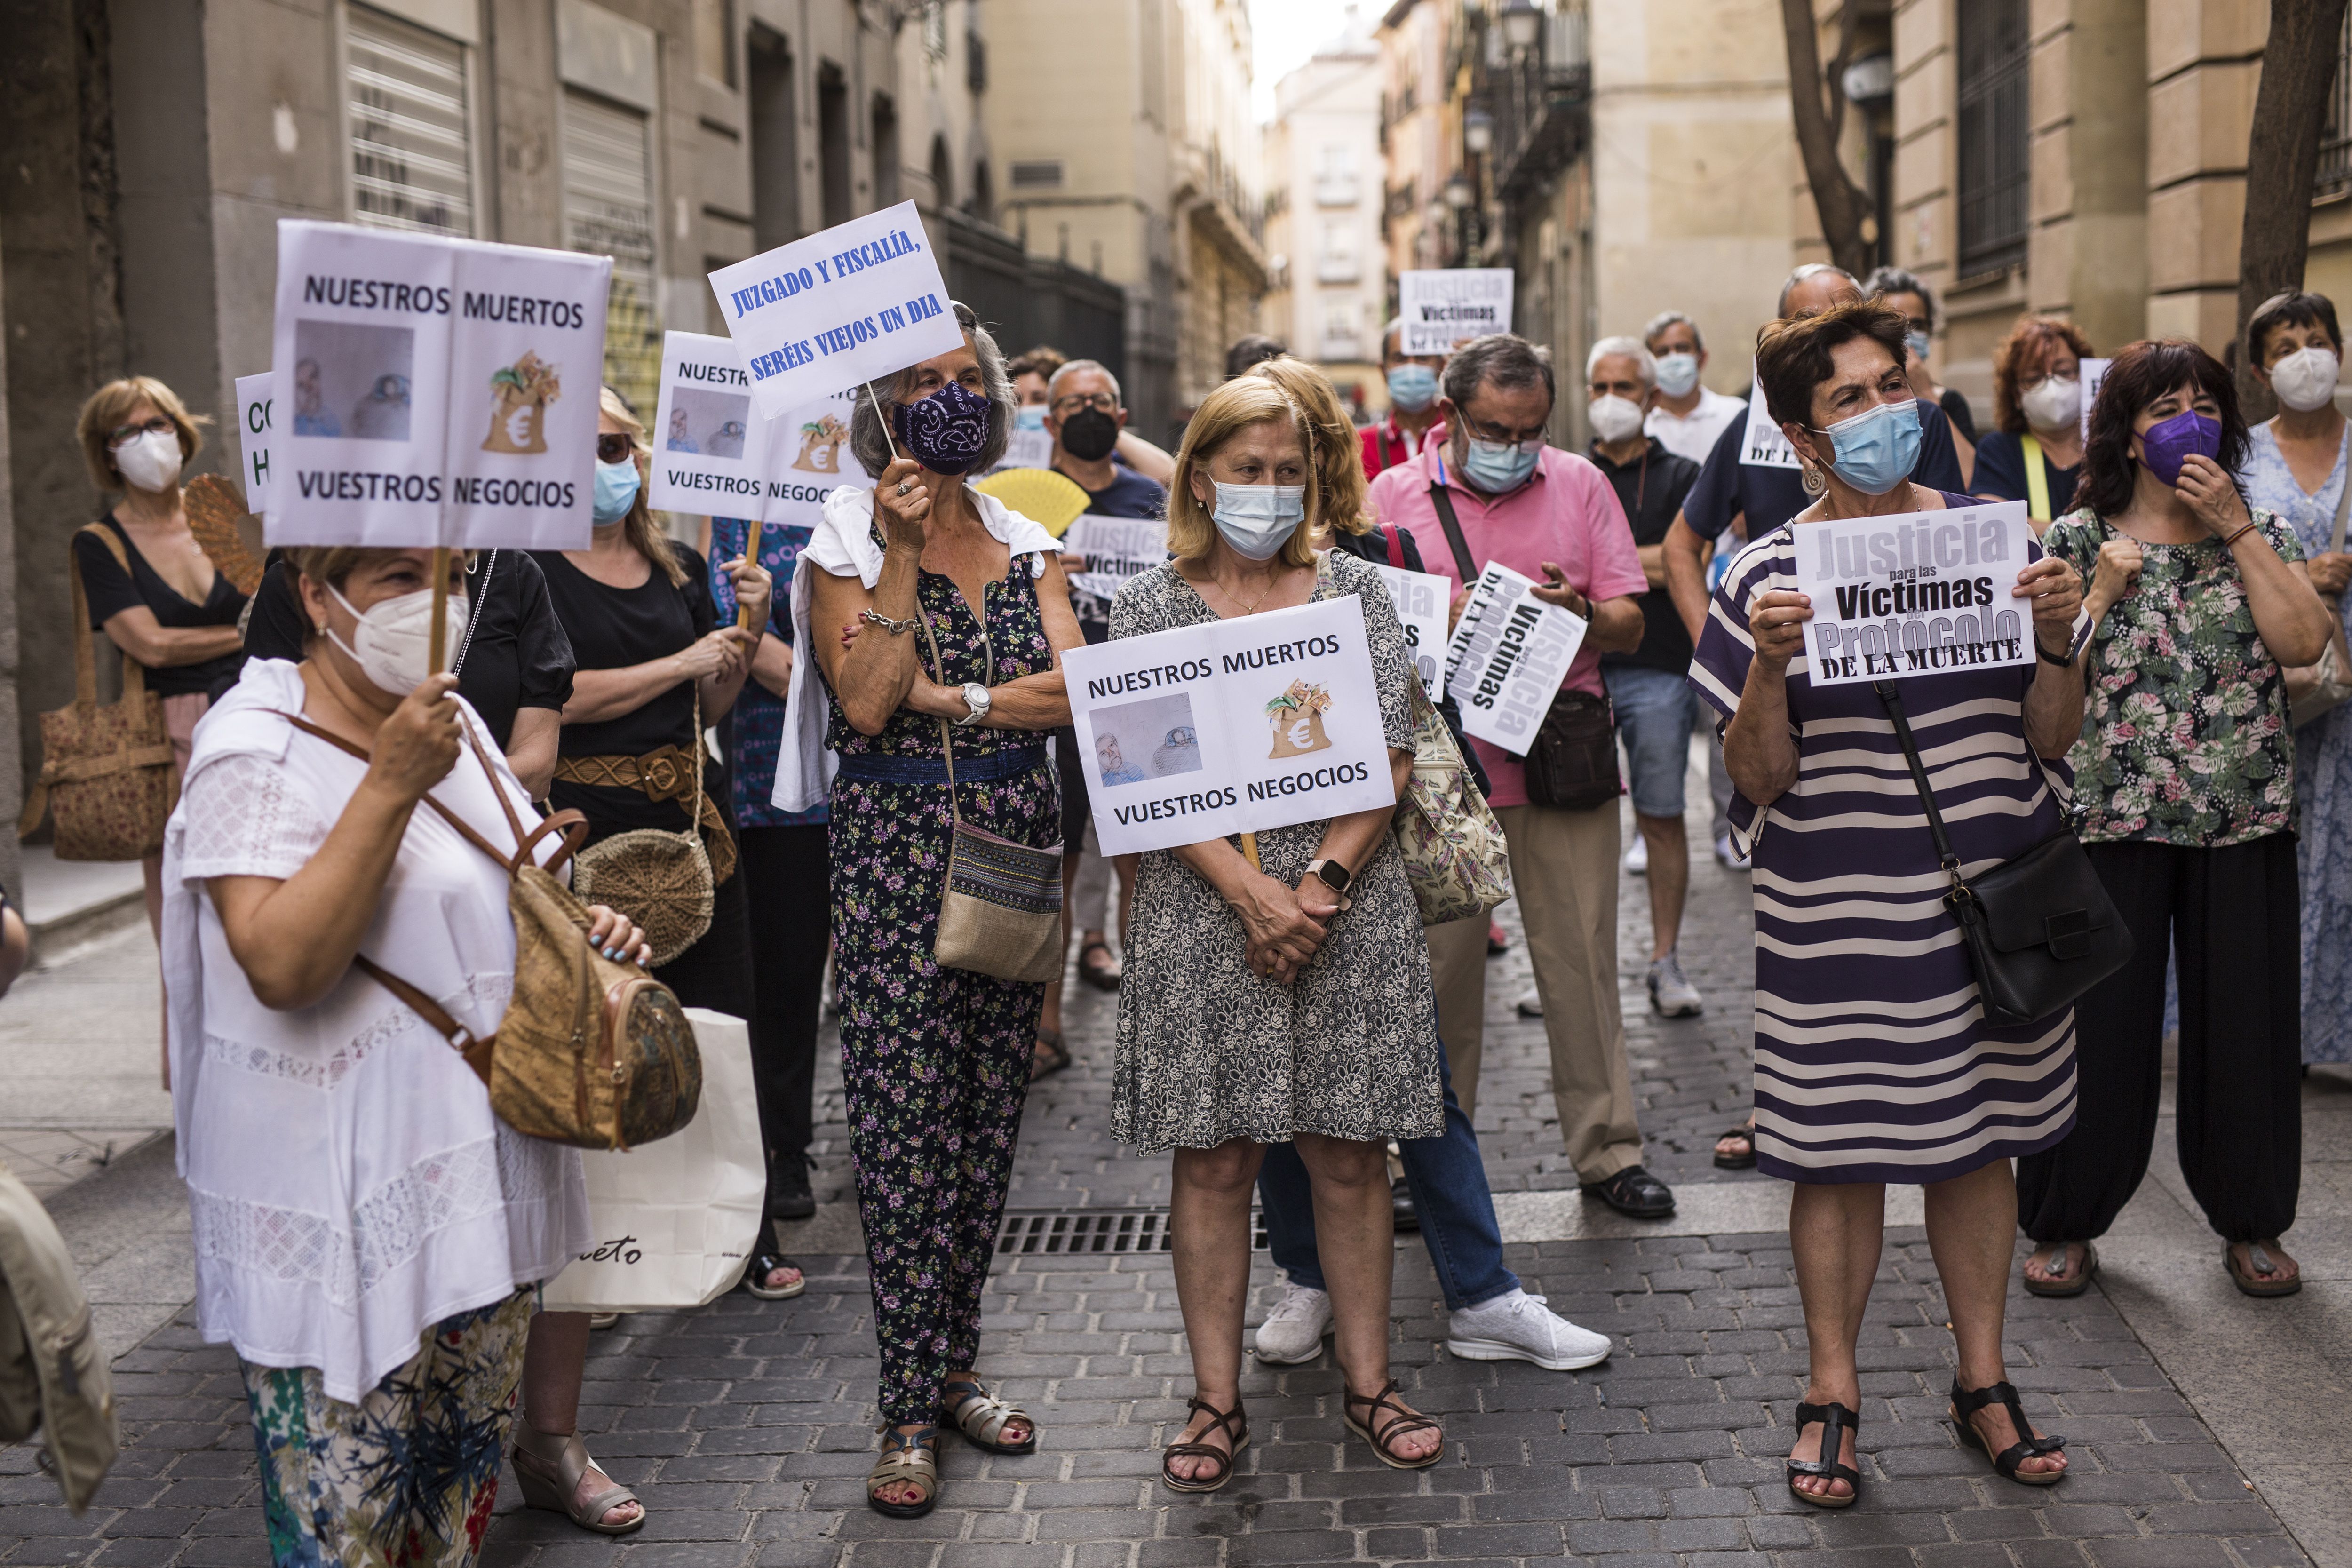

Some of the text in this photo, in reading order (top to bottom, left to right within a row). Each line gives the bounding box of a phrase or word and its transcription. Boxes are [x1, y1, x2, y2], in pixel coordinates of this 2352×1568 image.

[304, 275, 584, 329] NUESTROS MUERTOS
[731, 230, 921, 318] JUZGADO Y FISCALÍA,
[750, 293, 943, 381] SERÉIS VIEJOS UN DIA
[297, 470, 575, 508] VUESTROS NEGOCIOS
[668, 470, 834, 503] VUESTROS NEGOC
[1816, 513, 2010, 581] Justicia
[1890, 565, 1937, 581] para las
[1478, 571, 1501, 598] DE
[1835, 576, 1994, 621] Víctimas
[1906, 606, 1925, 620] del
[1473, 604, 1543, 710] Víctimas
[1814, 605, 2022, 666] Protocolo
[1821, 638, 2023, 679] DE LA MUERTE
[1088, 634, 1340, 699] NUESTROS MUERTOS
[1494, 605, 1581, 737] Justicia
[1113, 762, 1369, 825] VUESTROS NEGOCIOS
